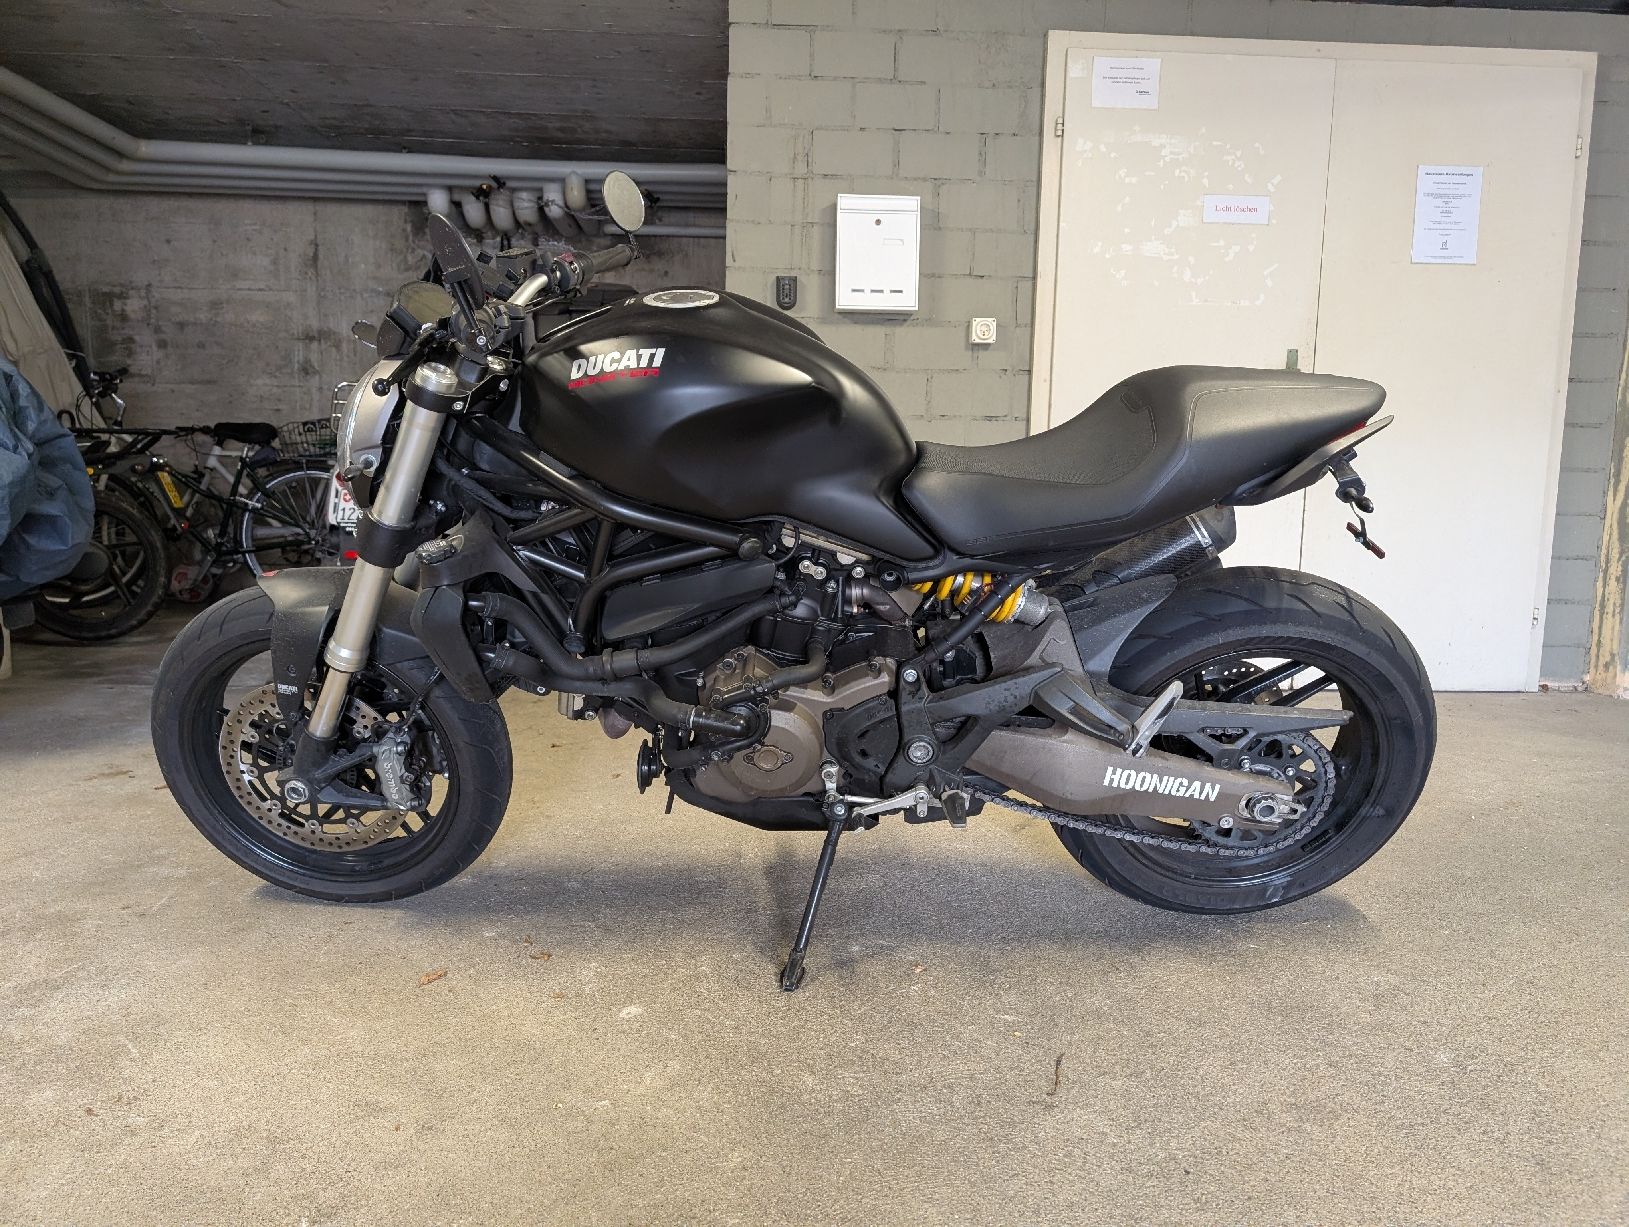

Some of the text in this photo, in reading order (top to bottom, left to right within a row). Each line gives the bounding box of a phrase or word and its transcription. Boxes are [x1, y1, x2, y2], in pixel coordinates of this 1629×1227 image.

[1215, 204, 1258, 213] Licht löschen
[570, 347, 666, 380] DUCATI
[1103, 766, 1221, 802] HOONIGAN
